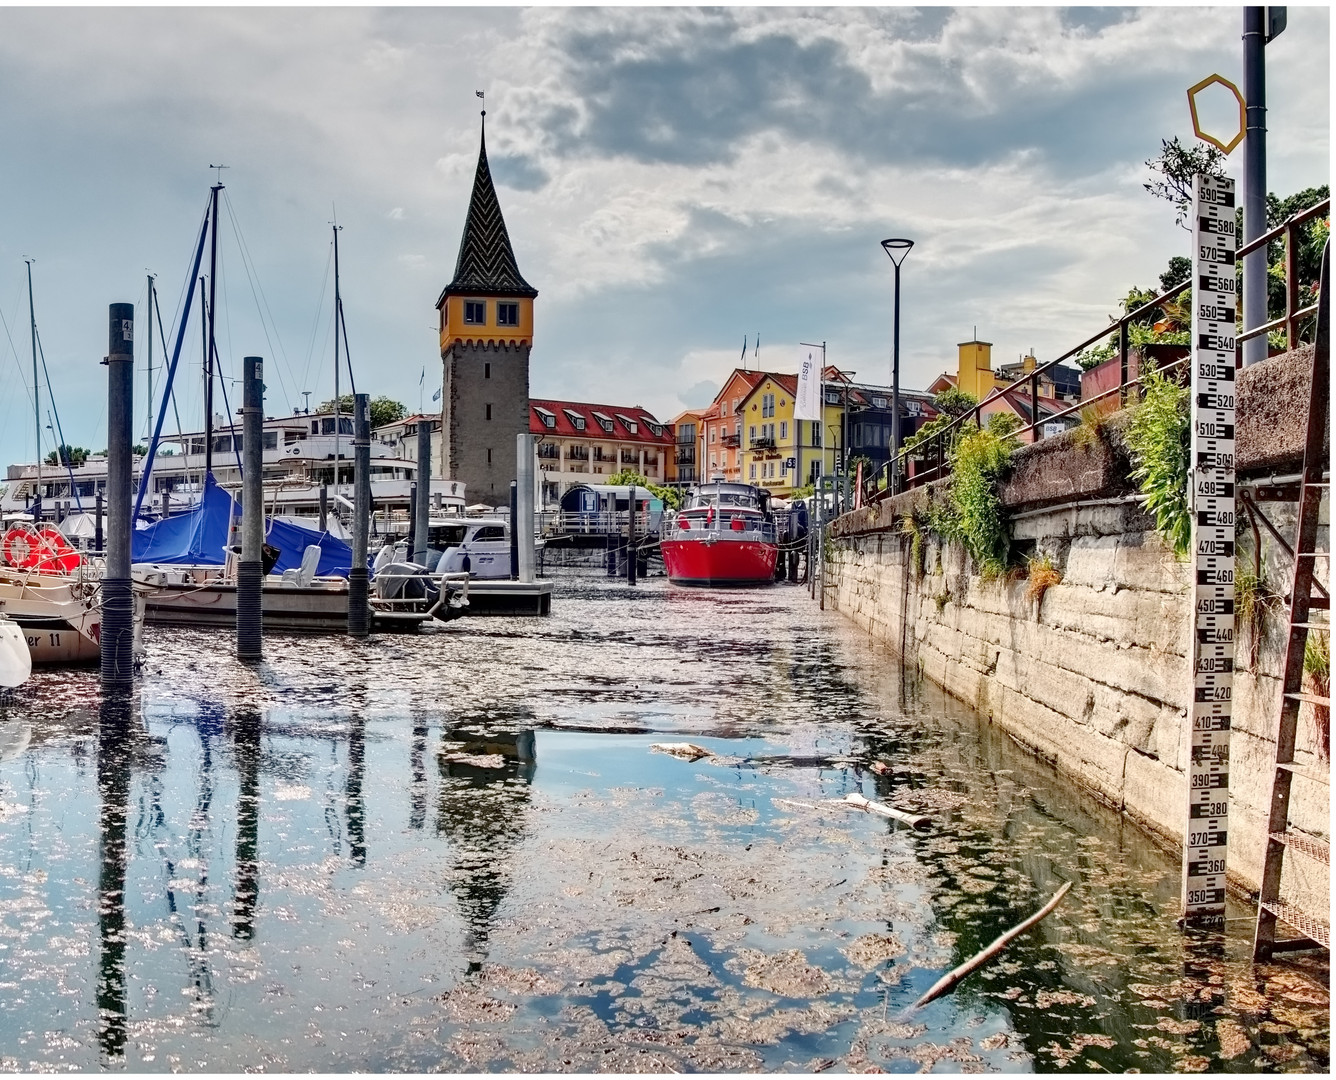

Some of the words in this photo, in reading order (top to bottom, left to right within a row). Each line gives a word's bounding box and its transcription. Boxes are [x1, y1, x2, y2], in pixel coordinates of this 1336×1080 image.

[1201, 187, 1216, 200] 590
[1218, 220, 1234, 233] 580
[1201, 246, 1216, 259] 570
[1218, 278, 1234, 290] 560
[1201, 305, 1216, 318] 550
[1218, 336, 1234, 349] 540
[1200, 364, 1216, 377] 530
[1218, 395, 1233, 408] 520
[1200, 424, 1214, 435] 510
[1217, 512, 1233, 524] 480
[1199, 541, 1215, 553] 470
[1217, 570, 1233, 582] 460
[1198, 600, 1214, 612] 450
[25, 636, 41, 647] er
[50, 634, 60, 646] 11
[1217, 629, 1232, 641] 440
[1198, 658, 1214, 670] 430
[1215, 687, 1231, 699] 420
[1195, 716, 1211, 728] 410
[1193, 774, 1209, 786] 390
[1211, 802, 1227, 815] 380
[1191, 832, 1207, 845] 370
[1208, 860, 1225, 872] 360
[1188, 890, 1205, 902] 350
